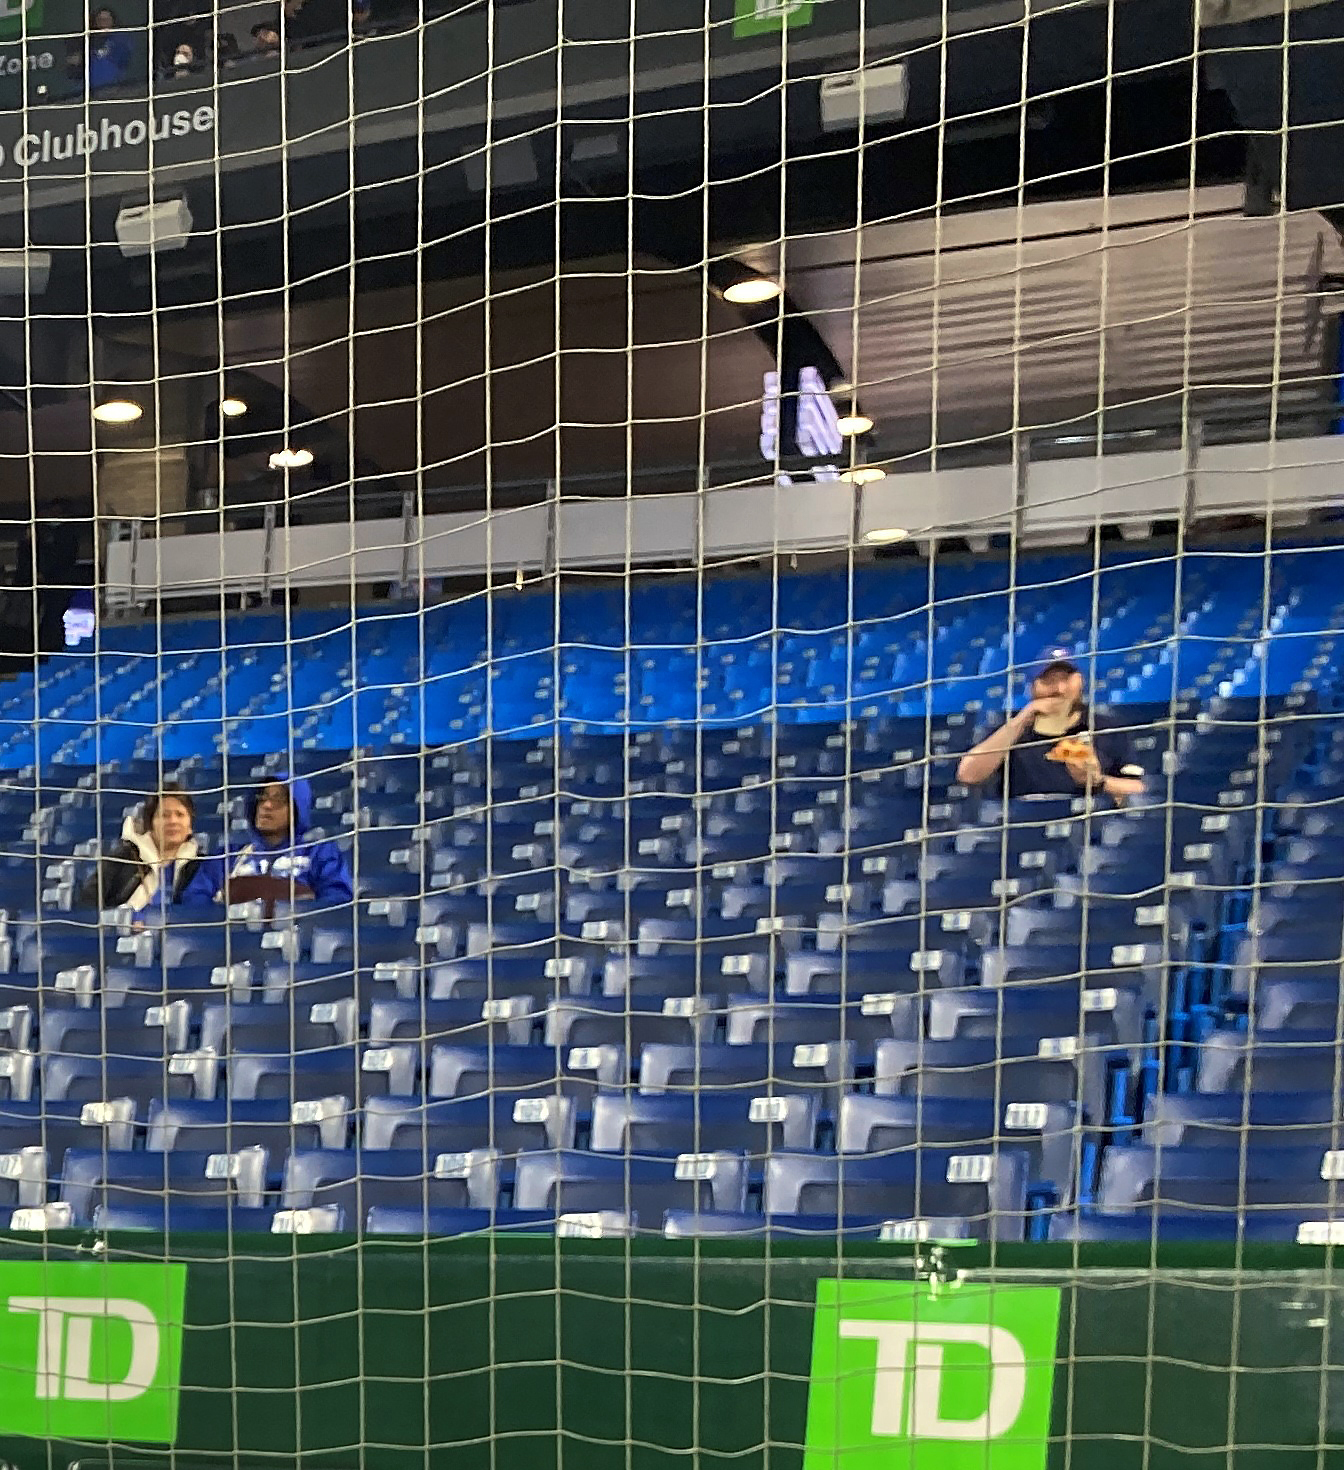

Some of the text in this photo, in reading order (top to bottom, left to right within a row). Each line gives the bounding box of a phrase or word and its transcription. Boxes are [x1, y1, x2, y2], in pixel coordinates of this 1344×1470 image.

[13, 105, 214, 167] Clubhouse
[7, 1295, 160, 1402] TD
[838, 1318, 1026, 1441] TD
